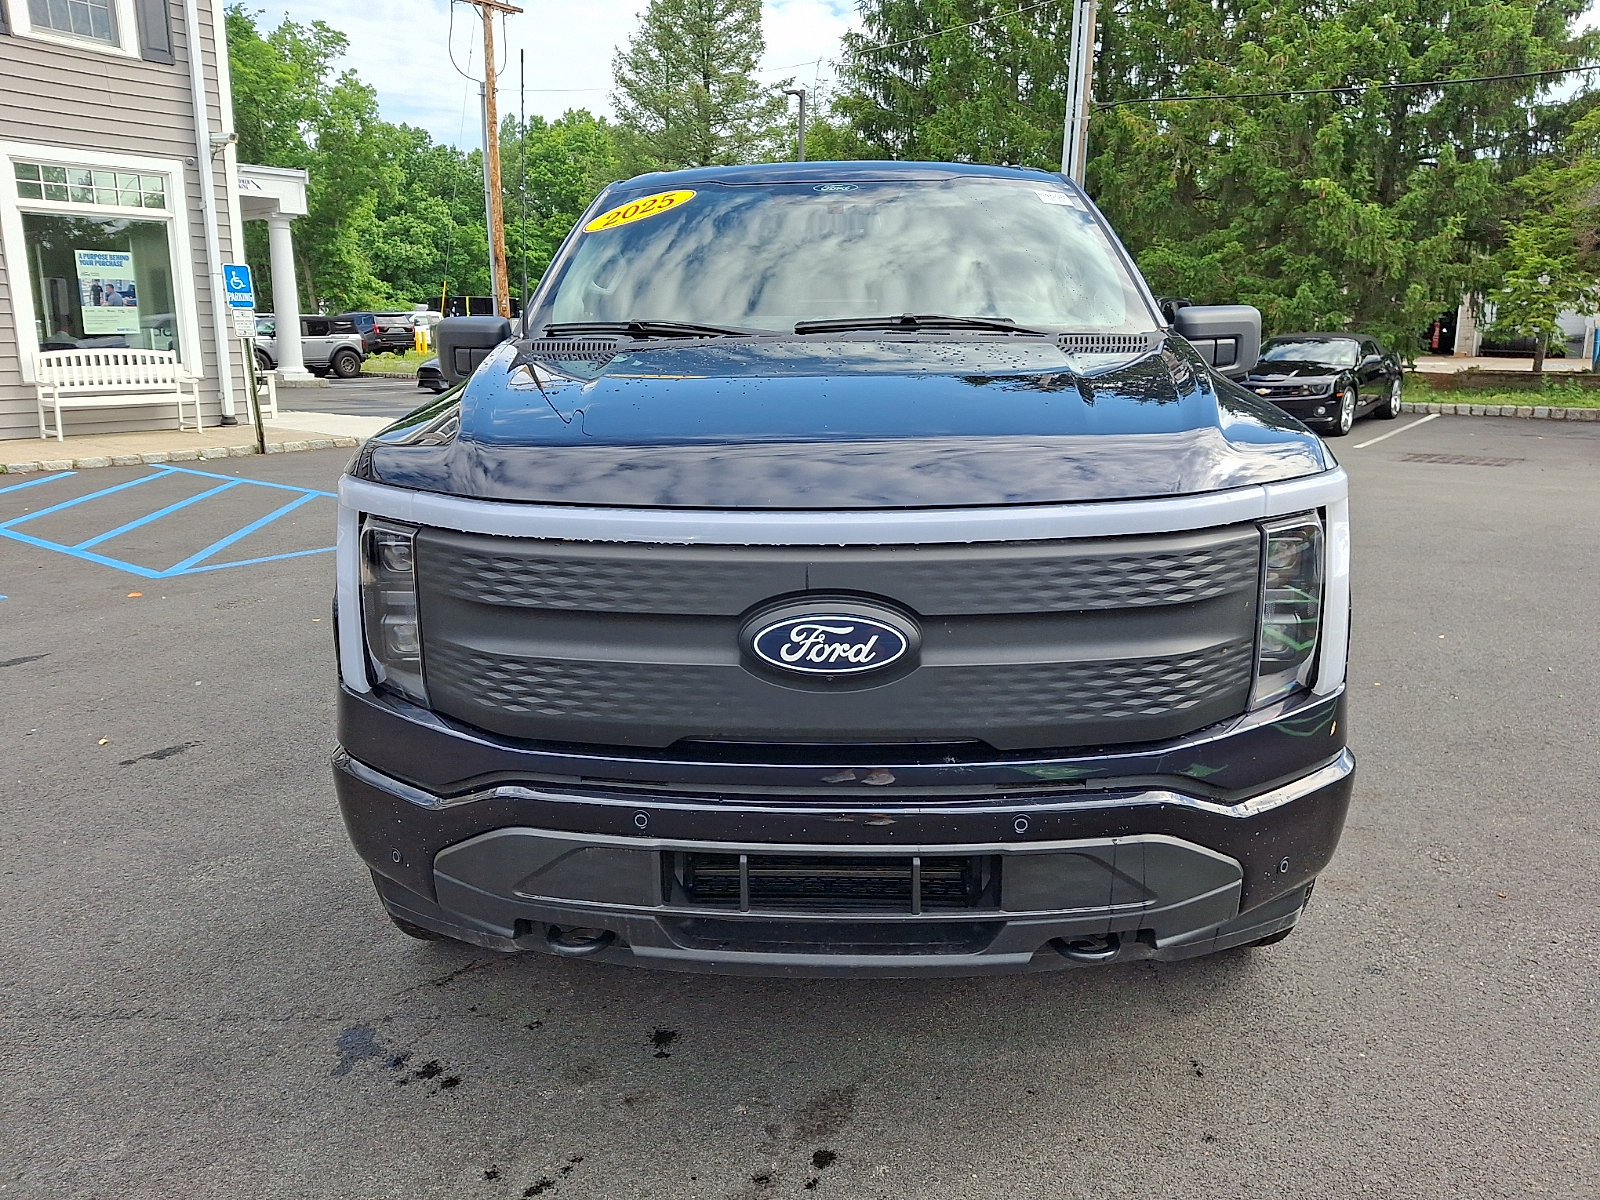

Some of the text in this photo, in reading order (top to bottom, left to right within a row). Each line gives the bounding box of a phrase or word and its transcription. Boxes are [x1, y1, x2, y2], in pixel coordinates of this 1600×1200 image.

[603, 193, 676, 227] 2025
[227, 292, 253, 301] PARKING
[780, 624, 879, 663] Ford
